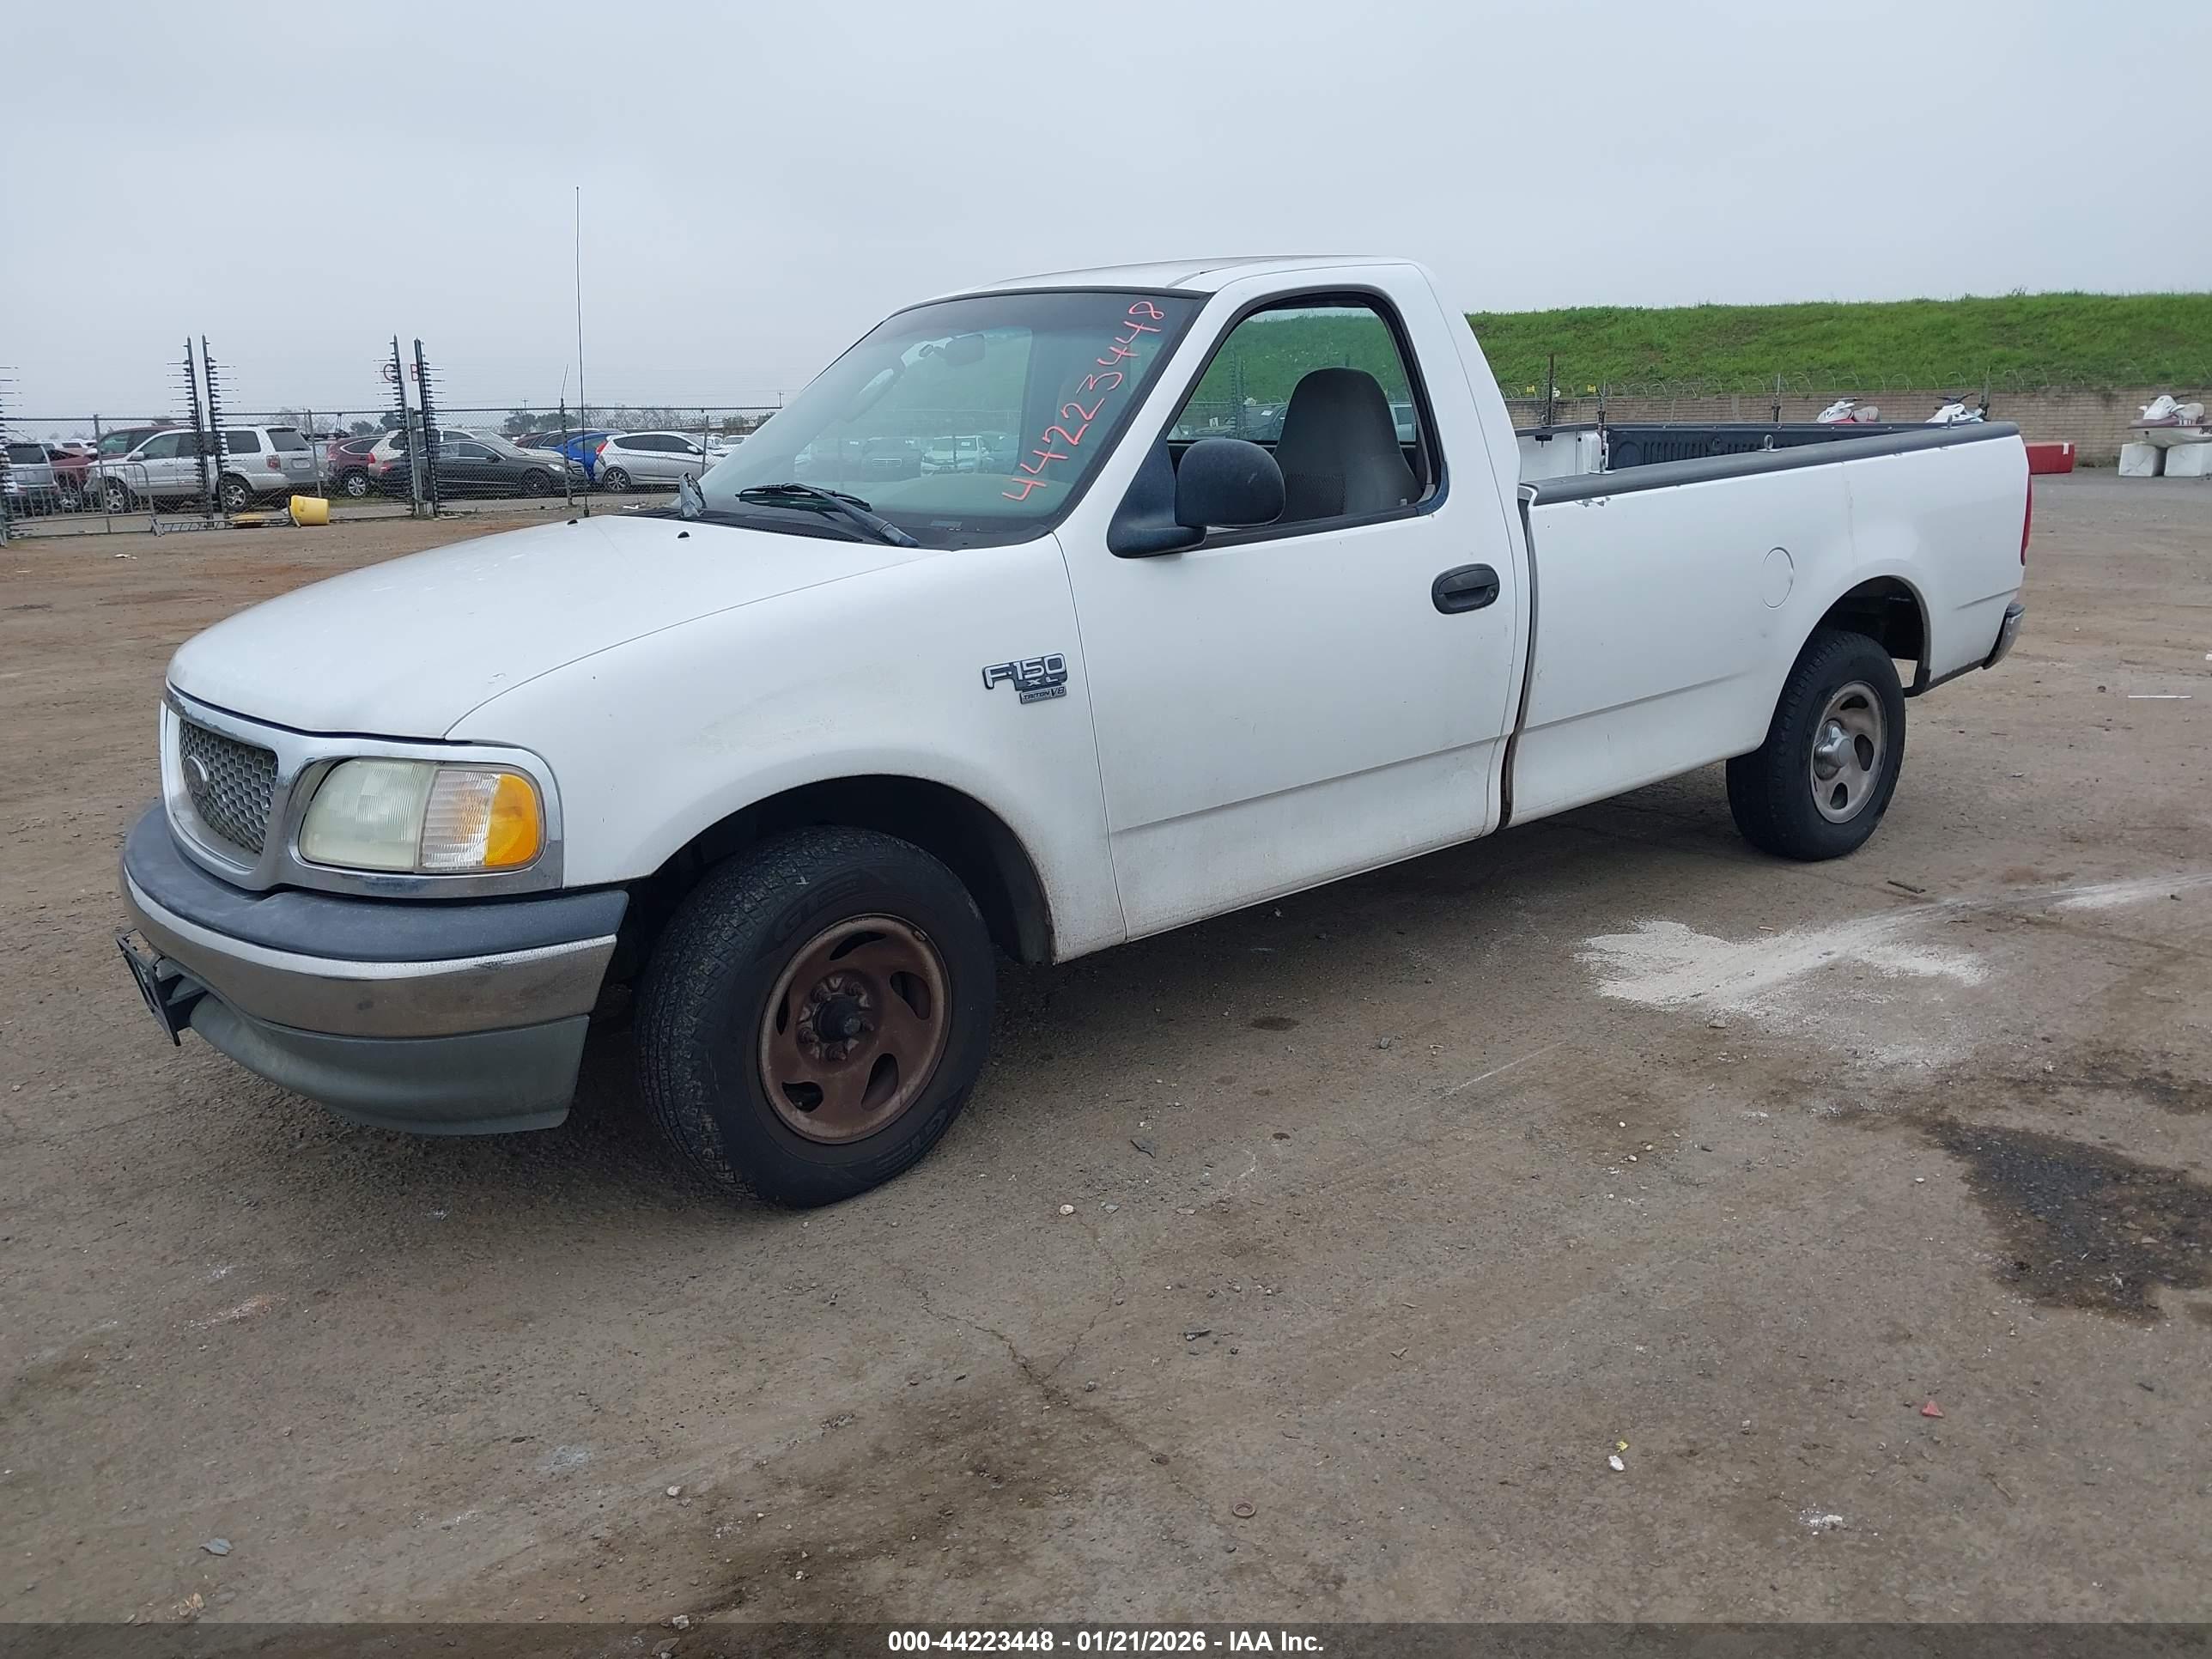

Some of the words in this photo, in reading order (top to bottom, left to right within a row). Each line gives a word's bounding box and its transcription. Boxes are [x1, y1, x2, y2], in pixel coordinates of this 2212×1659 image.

[1002, 301, 1164, 501] 44223448
[1023, 691, 1050, 700] TRITON
[1050, 687, 1065, 697] V8
